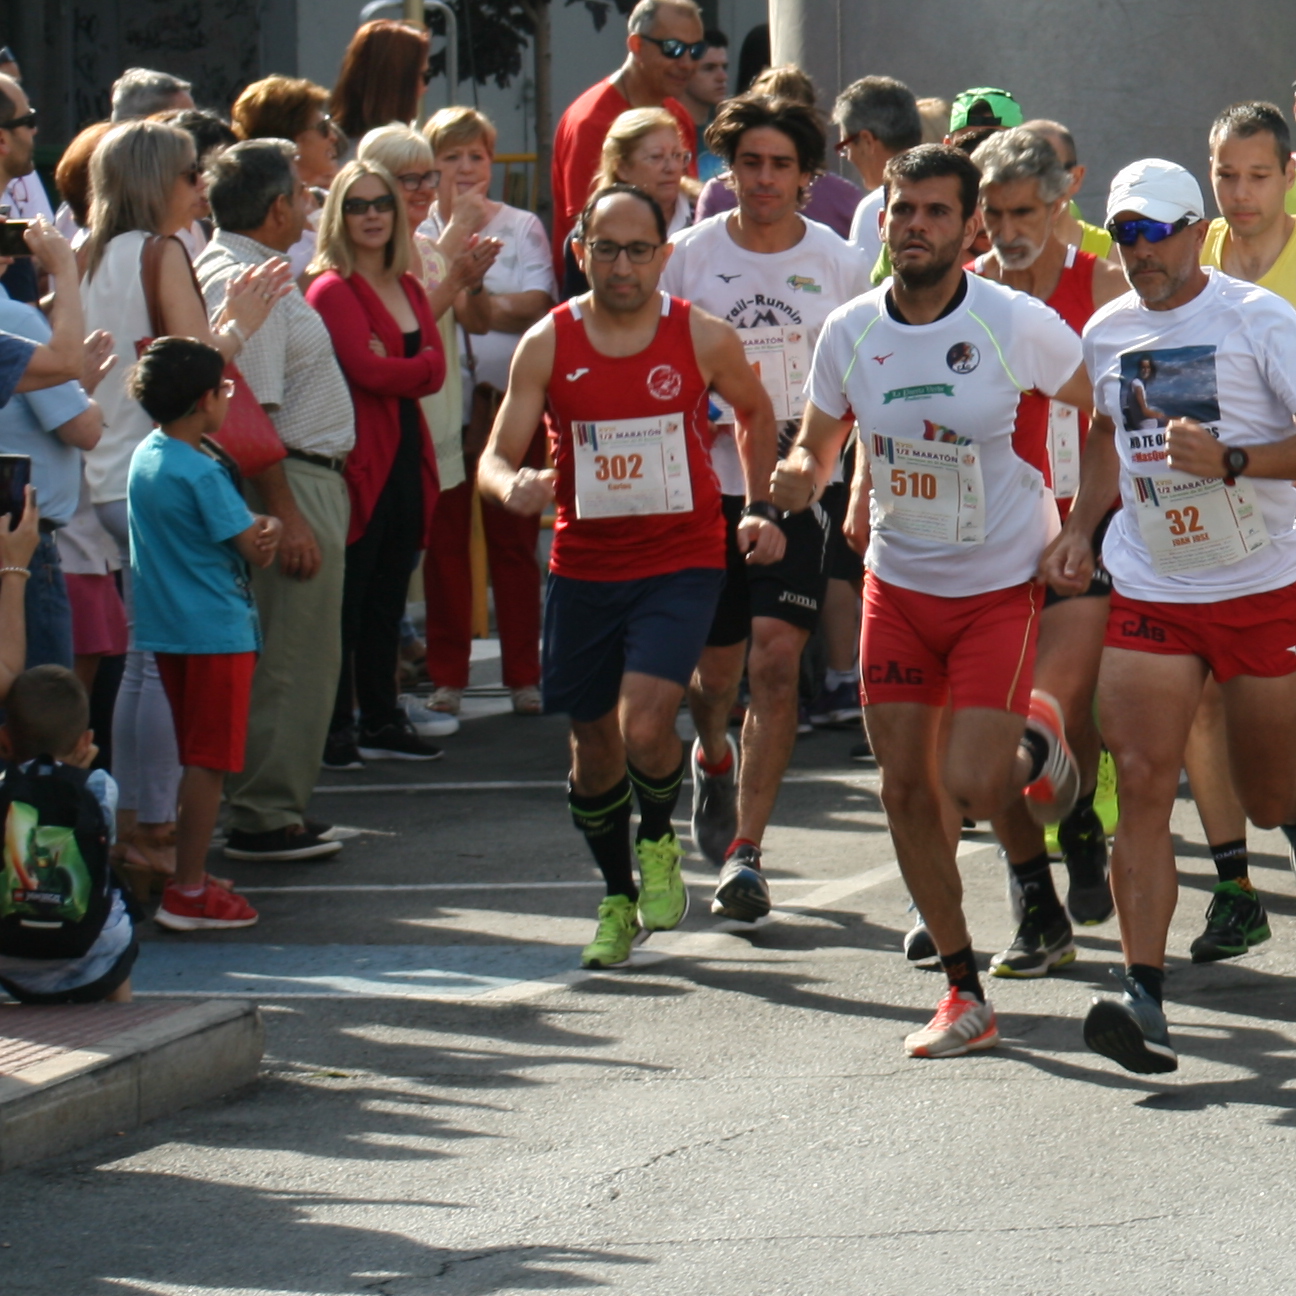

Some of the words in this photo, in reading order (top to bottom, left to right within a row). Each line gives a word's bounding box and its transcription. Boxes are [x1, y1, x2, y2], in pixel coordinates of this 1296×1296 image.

[1143, 434, 1154, 448] TE
[594, 453, 643, 482] 302
[912, 450, 958, 463] MARATÓN
[891, 469, 937, 500] 510
[1165, 506, 1204, 536] 32
